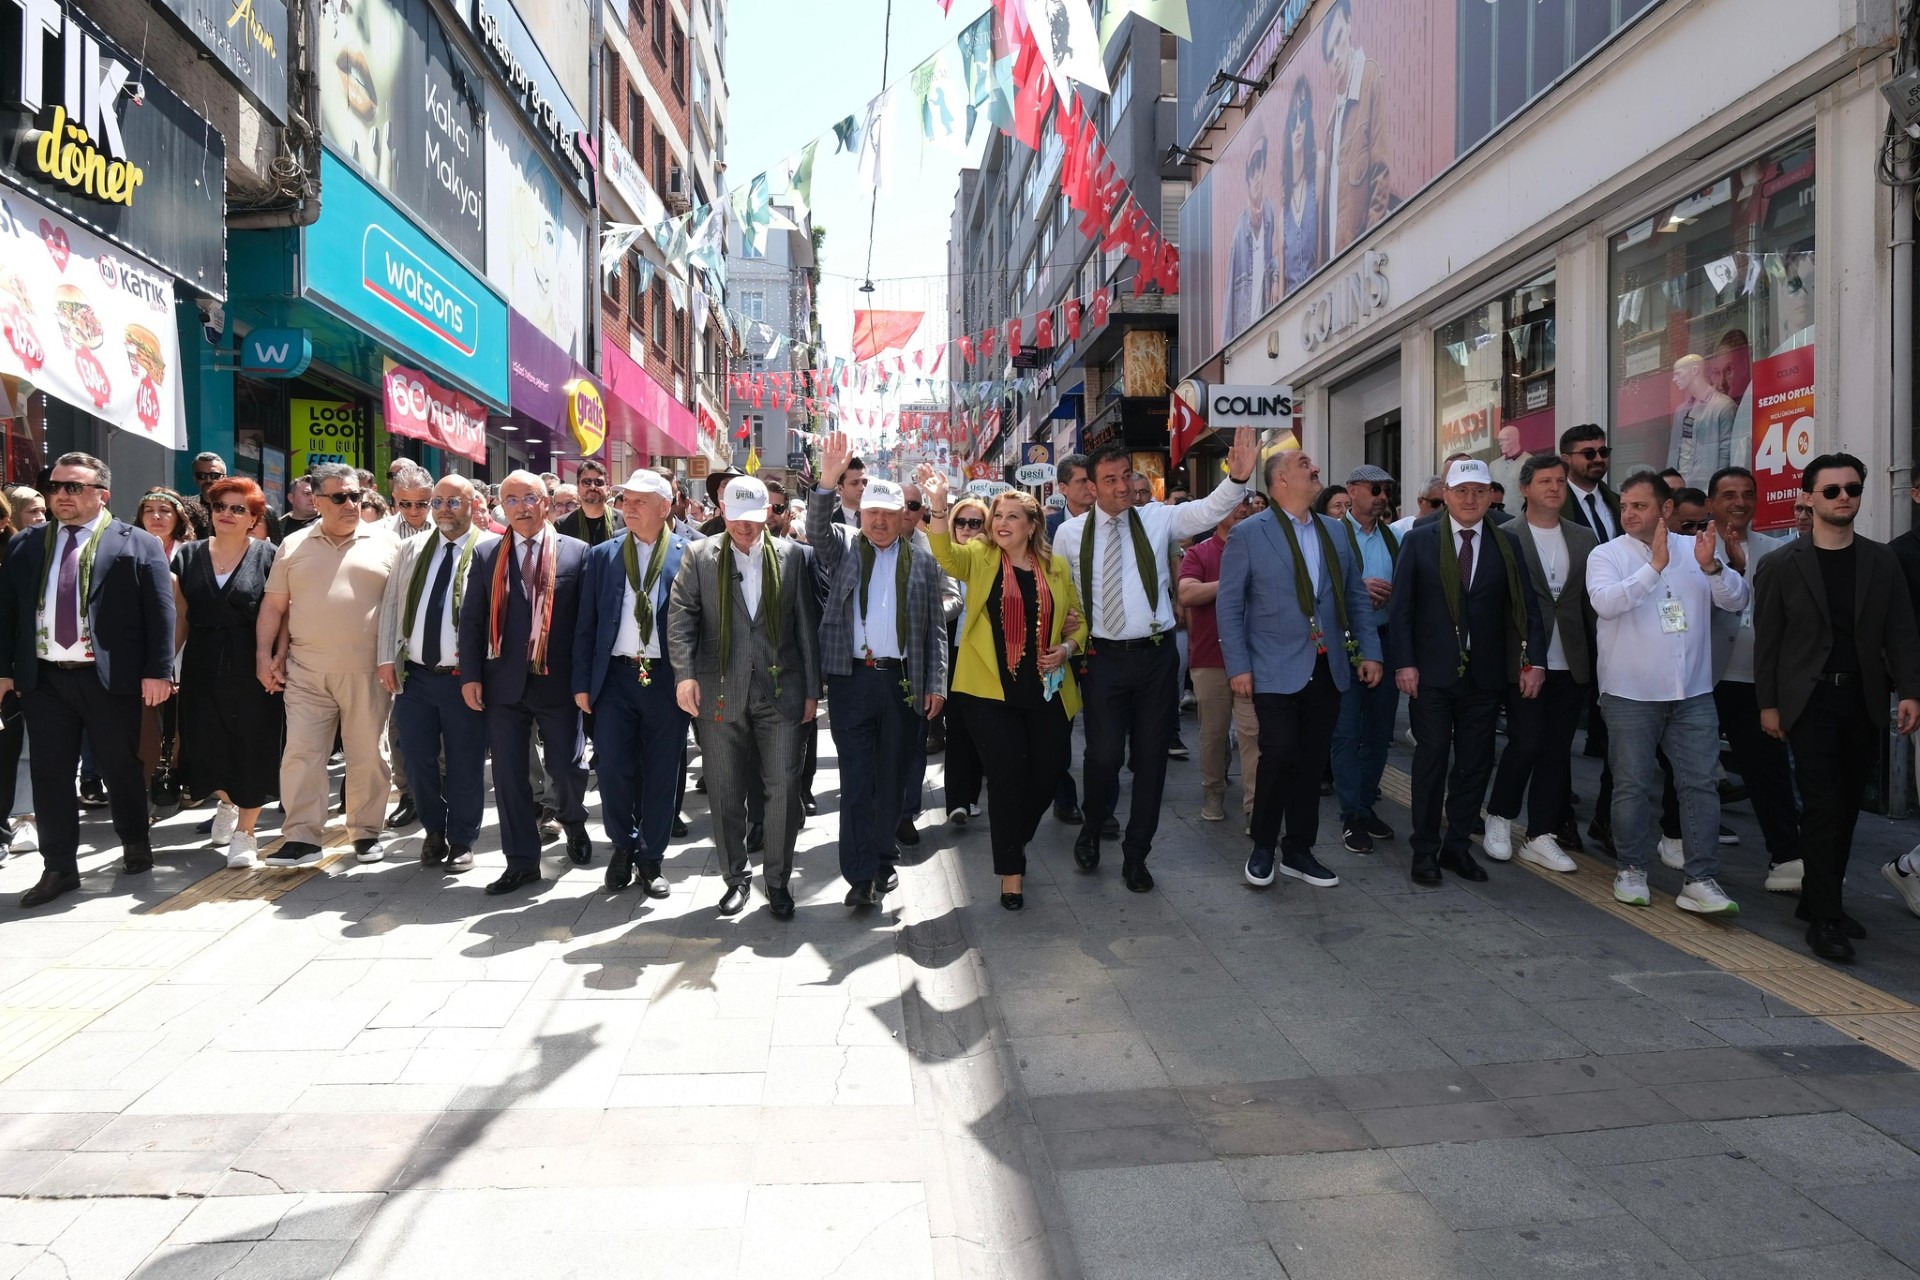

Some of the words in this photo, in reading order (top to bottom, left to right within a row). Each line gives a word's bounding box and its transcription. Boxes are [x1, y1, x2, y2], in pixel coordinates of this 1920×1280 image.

[36, 104, 143, 208] döner
[425, 130, 482, 231] Makyaj
[385, 250, 463, 333] watsons
[577, 390, 604, 432] gratis
[1214, 393, 1292, 416] COLIN'S
[1758, 392, 1786, 408] SEZON
